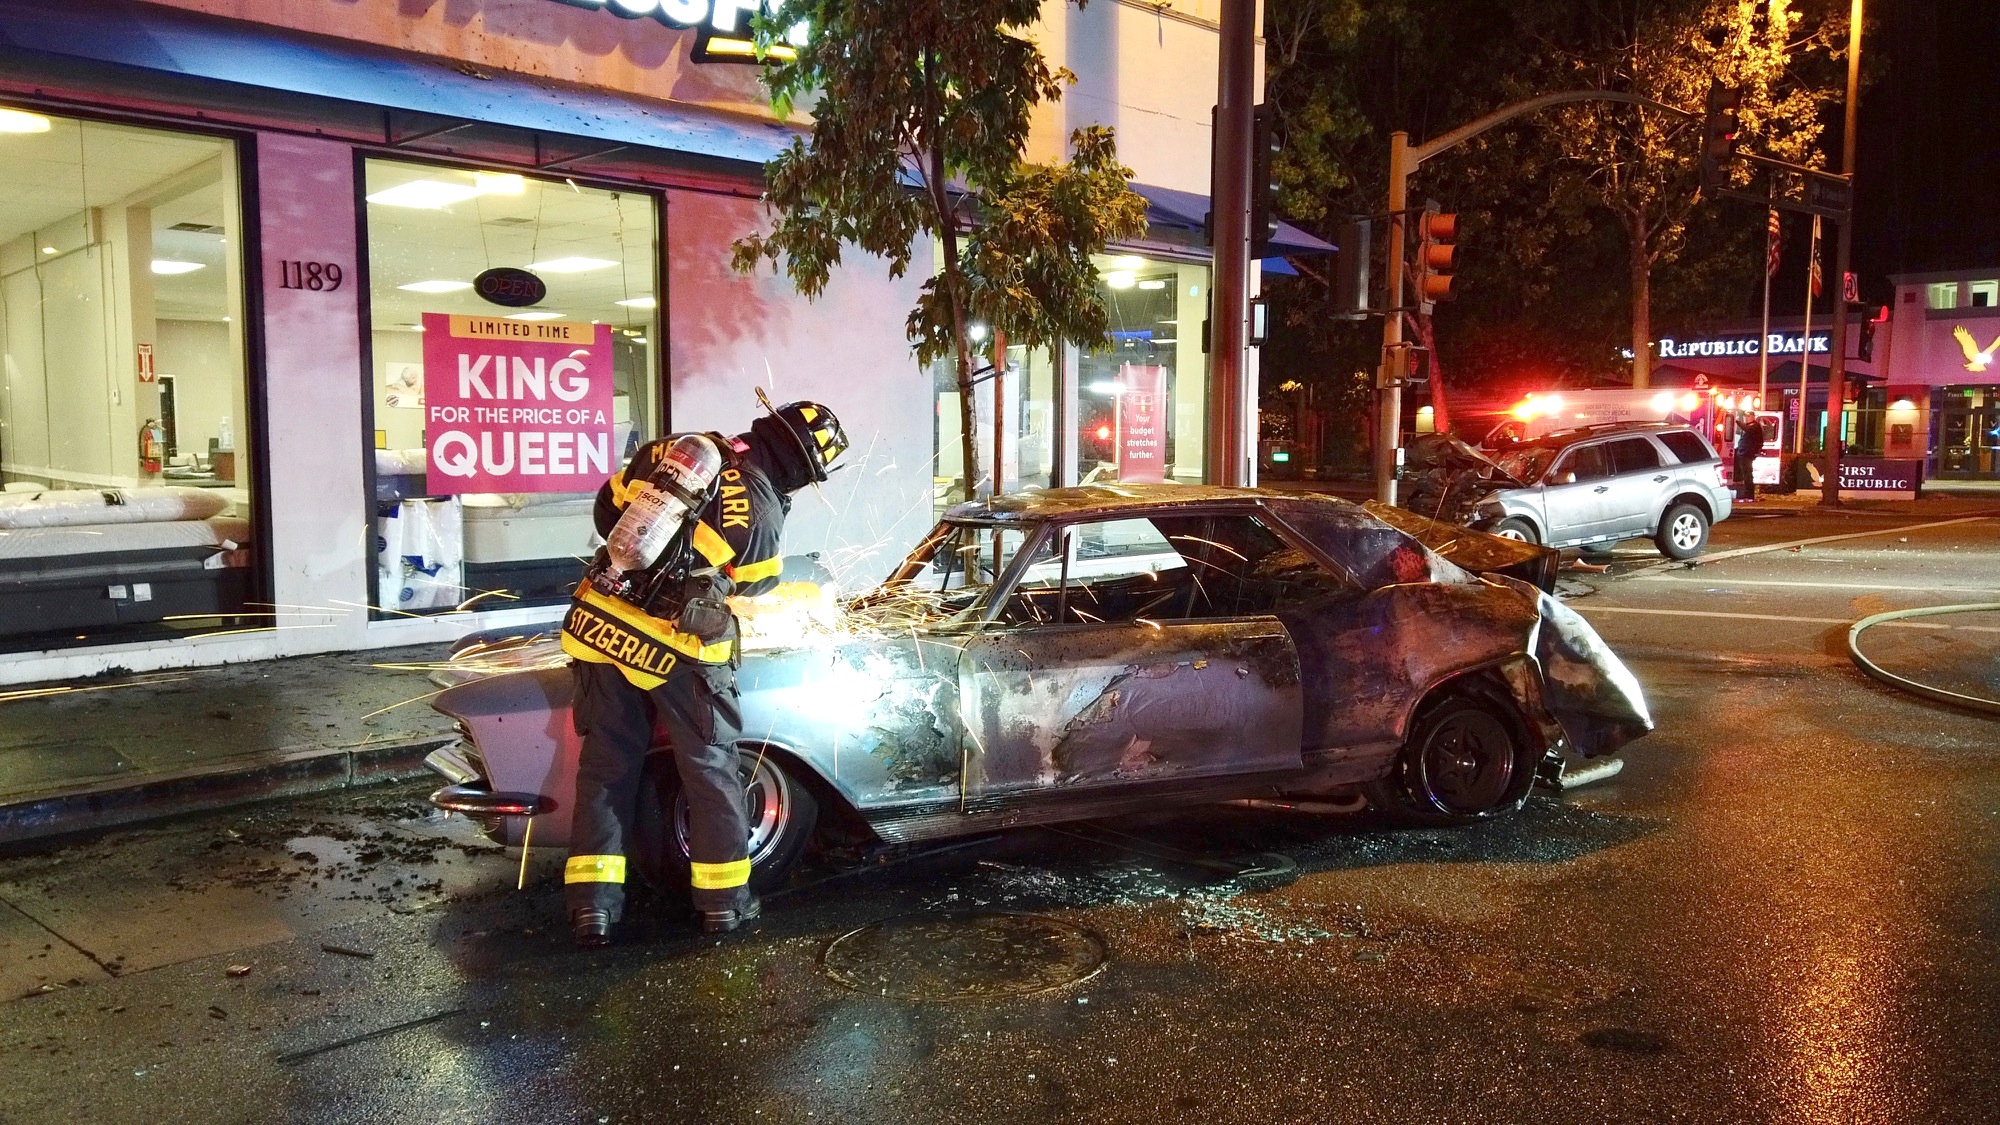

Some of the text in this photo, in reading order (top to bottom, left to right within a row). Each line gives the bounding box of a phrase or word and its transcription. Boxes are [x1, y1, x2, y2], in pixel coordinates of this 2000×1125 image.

[279, 260, 342, 291] 1189
[482, 276, 540, 297] OPEN
[470, 321, 570, 339] LIMITED TIME
[1659, 334, 1828, 358] REPUBLIC BANK
[458, 353, 590, 402] KING
[430, 406, 606, 425] FOR THE PRICE OF A
[1135, 414, 1150, 422] Your
[1130, 426, 1155, 436] budget
[1126, 438, 1158, 447] stretches
[433, 430, 609, 478] QUEEN
[1129, 450, 1155, 458] further.
[1839, 464, 1876, 475] FIRST
[1839, 476, 1907, 488] REPUBLIC
[720, 468, 750, 529] PARK
[569, 606, 677, 675] FITZGERALD
